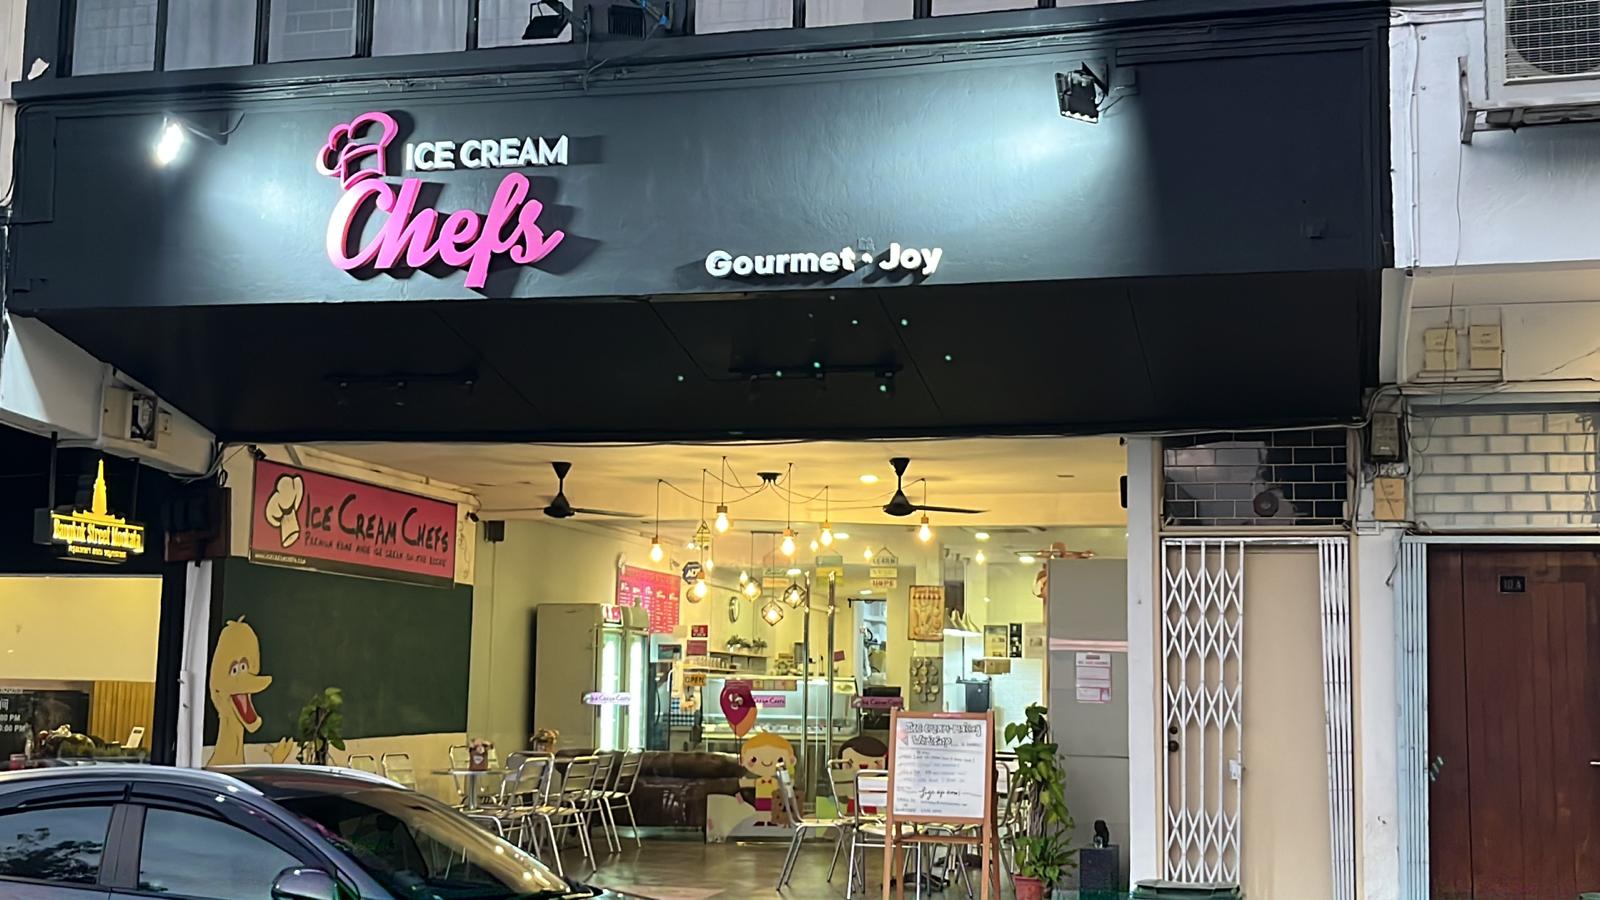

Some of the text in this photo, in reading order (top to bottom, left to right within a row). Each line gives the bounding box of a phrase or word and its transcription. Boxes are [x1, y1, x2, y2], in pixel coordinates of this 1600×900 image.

[405, 135, 569, 171] ICE CREAM
[326, 171, 565, 289] Chefs
[705, 242, 943, 278] Gourmet Joy
[53, 518, 86, 544] Bangkok
[87, 523, 110, 545] Street
[305, 493, 449, 554] ICE CREAM CHEFS
